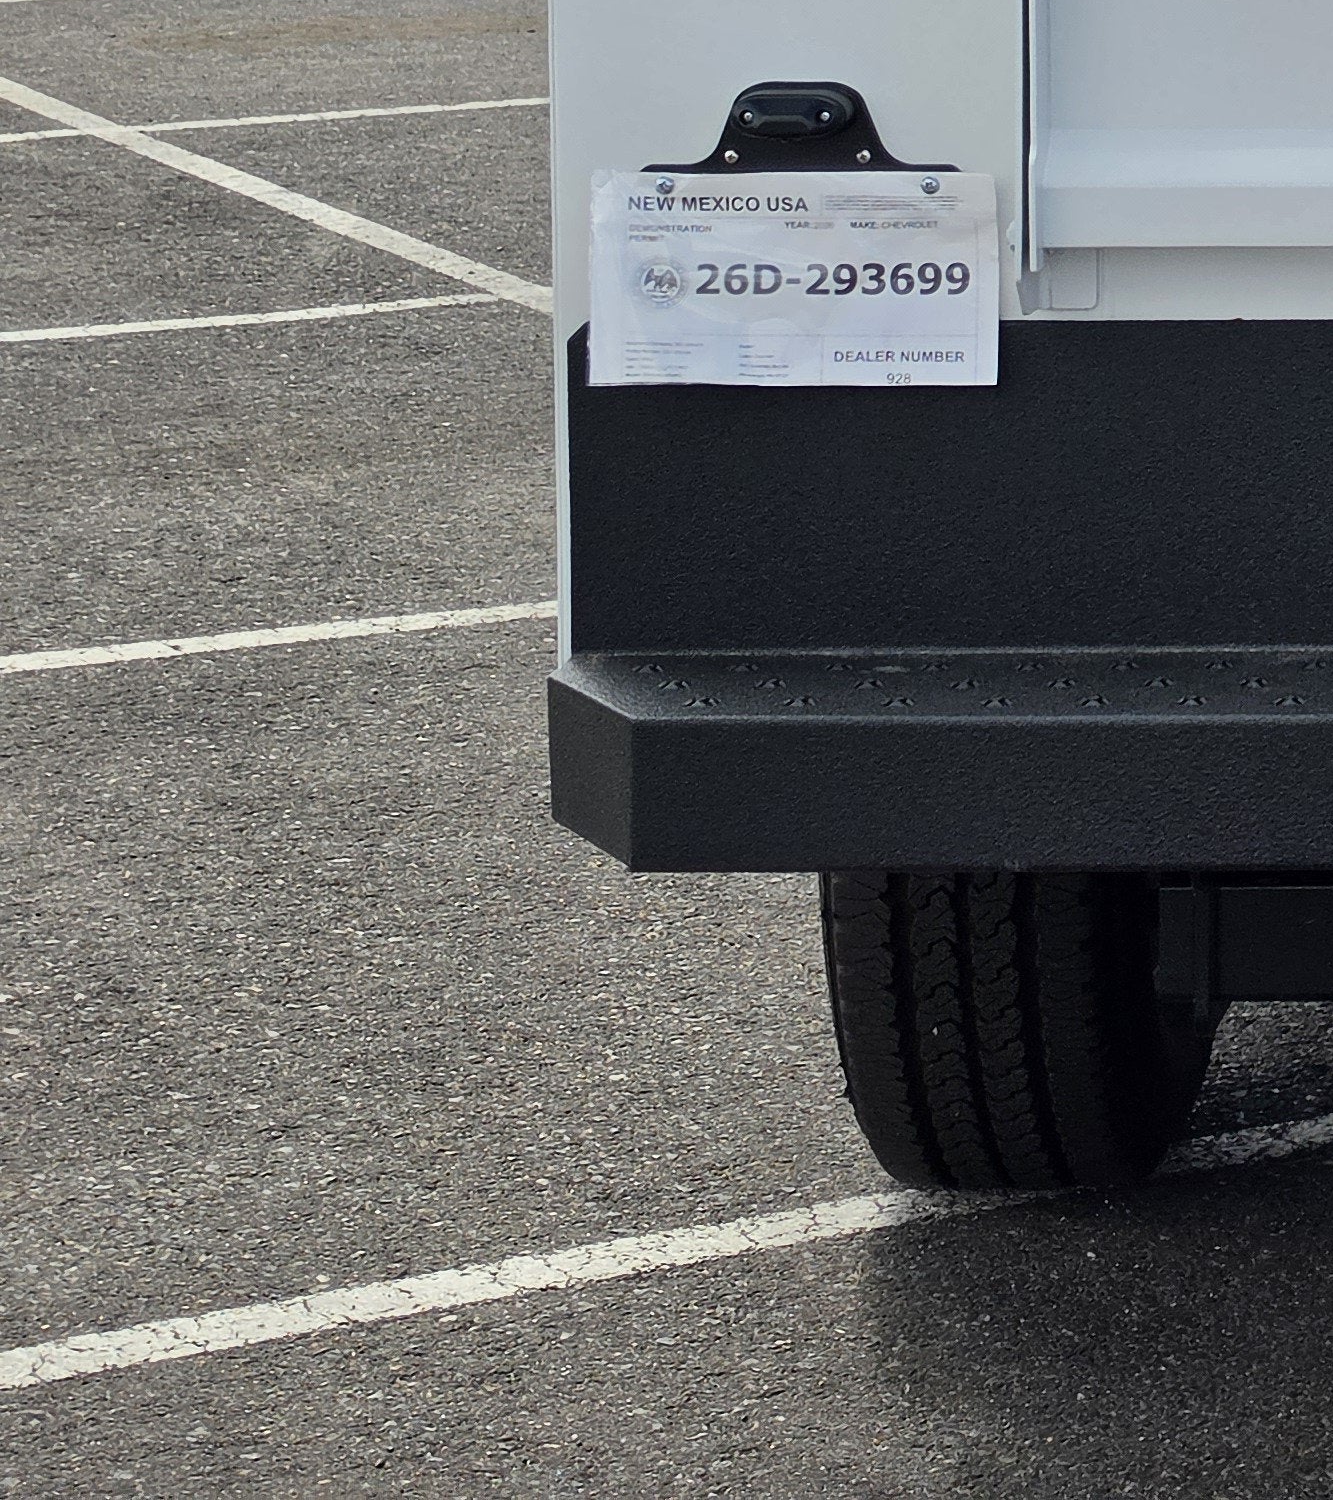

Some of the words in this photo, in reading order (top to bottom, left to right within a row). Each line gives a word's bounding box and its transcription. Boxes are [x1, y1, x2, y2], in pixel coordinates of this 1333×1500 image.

[627, 196, 674, 212] NEW
[681, 196, 760, 212] MEXICO
[766, 196, 809, 212] USA
[695, 262, 970, 296] 26D-293699
[833, 351, 895, 363] DEALER
[900, 351, 965, 363] NUMBER
[886, 372, 912, 385] 928
